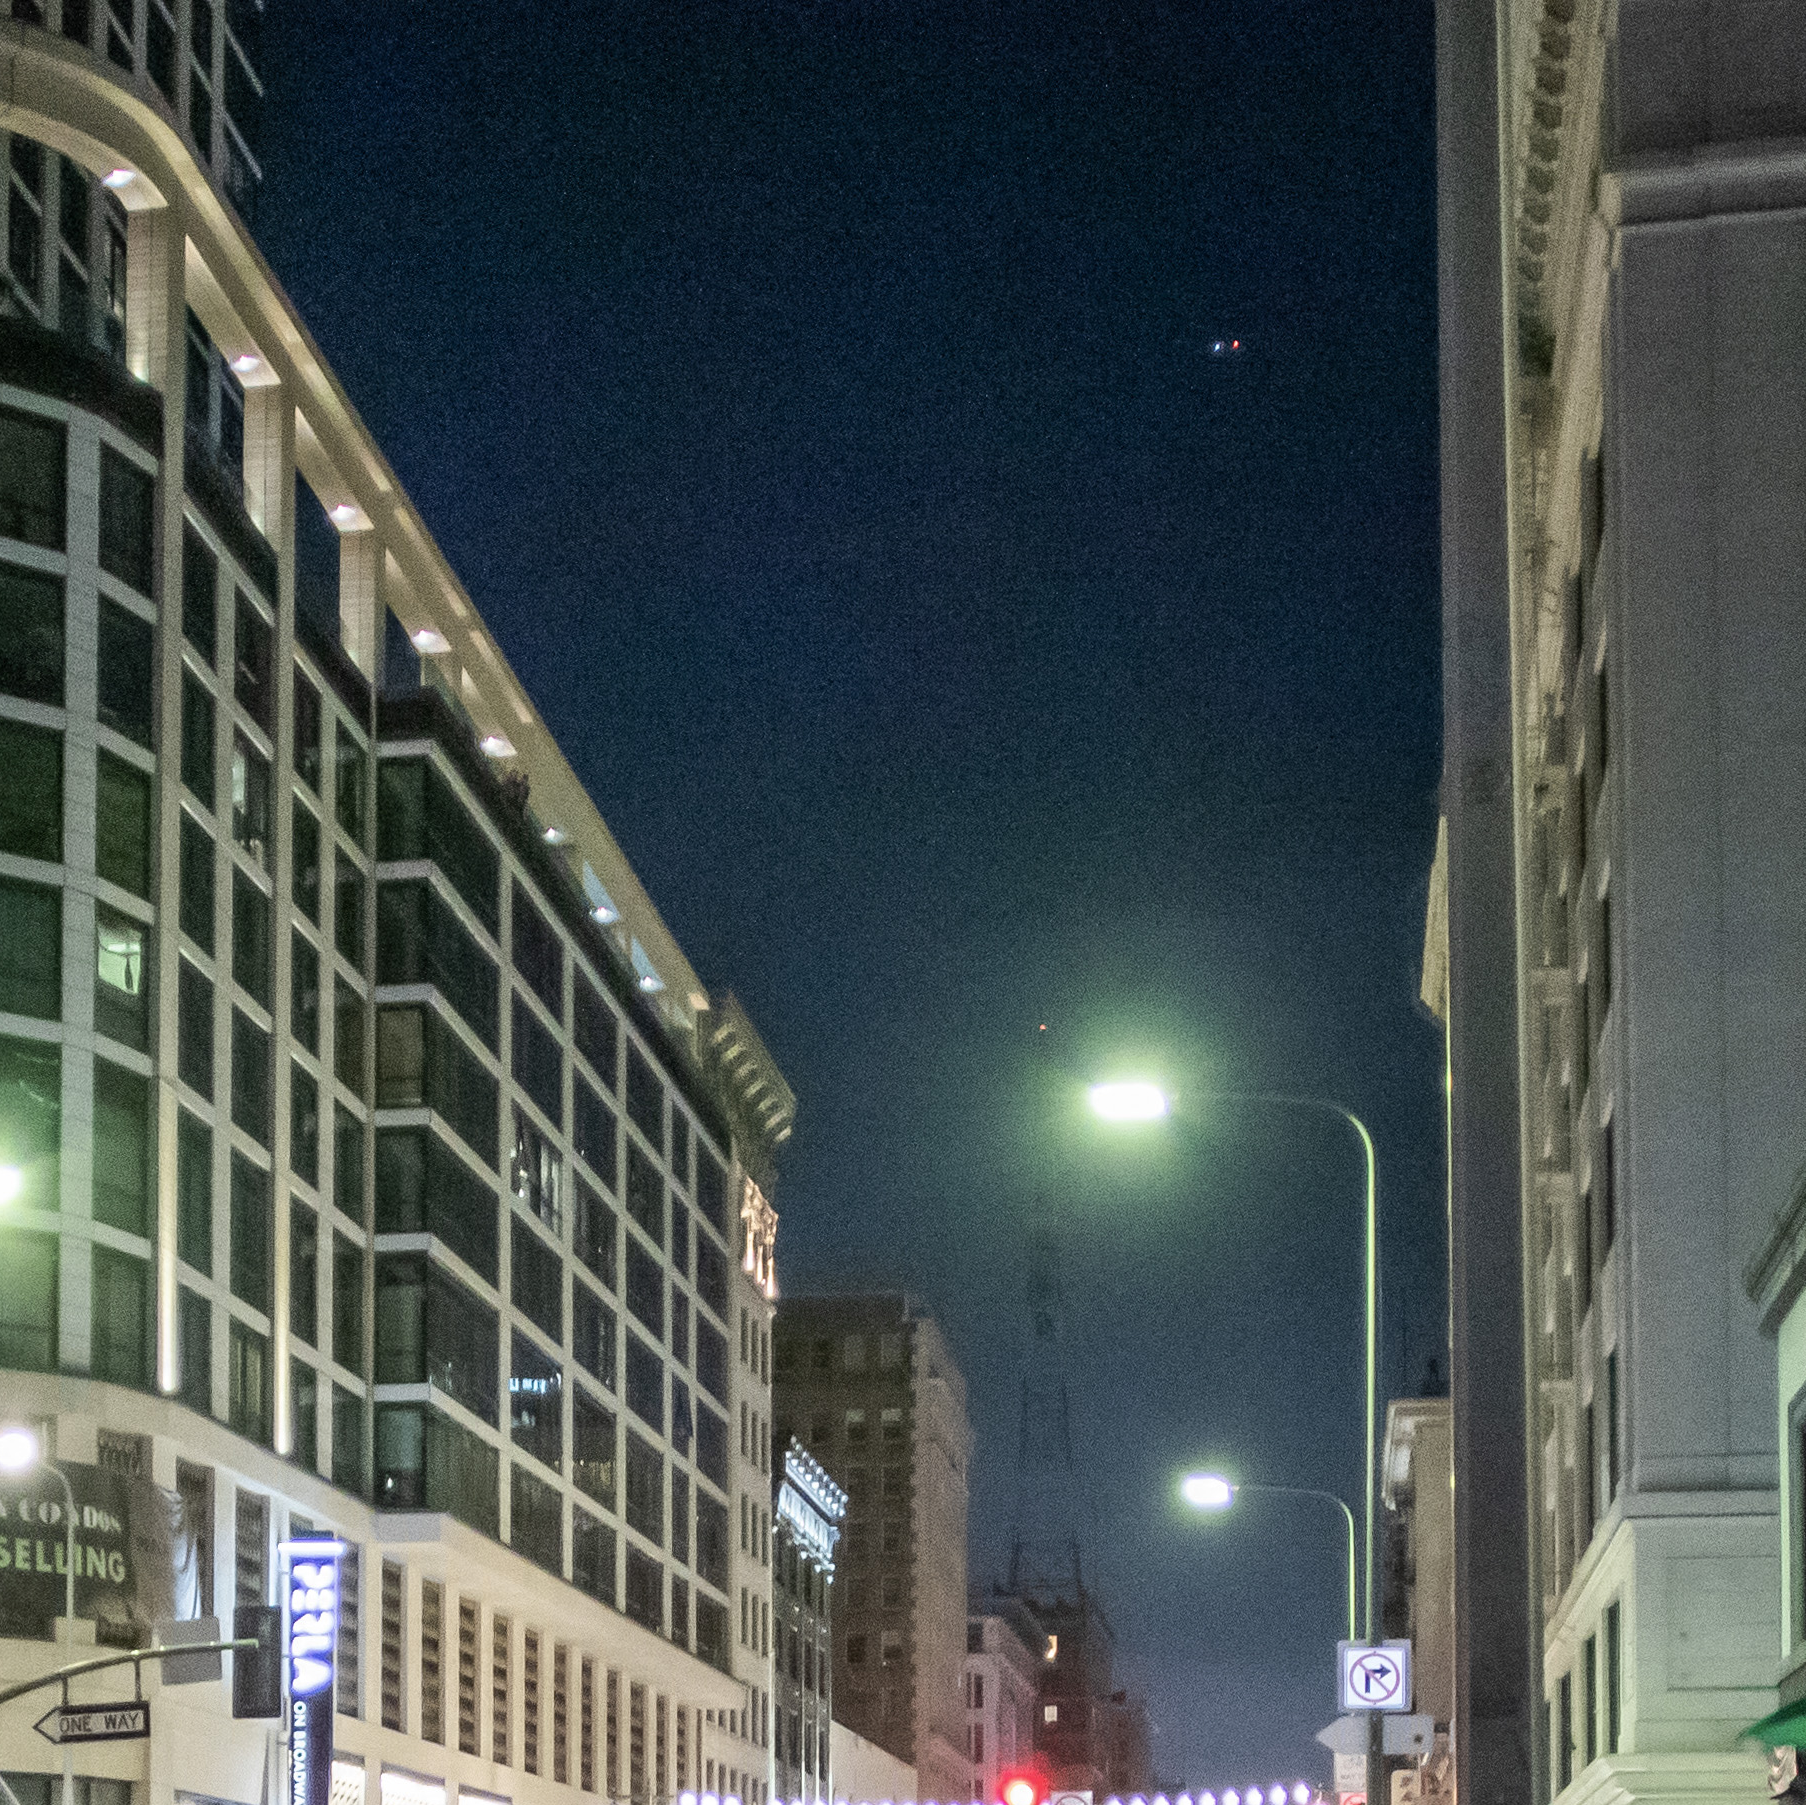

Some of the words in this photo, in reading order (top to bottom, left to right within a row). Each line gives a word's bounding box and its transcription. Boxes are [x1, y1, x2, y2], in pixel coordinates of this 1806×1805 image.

[292, 1561, 335, 1693] PERLA
[59, 1716, 92, 1733] ONE
[104, 1713, 139, 1730] WAY
[293, 1700, 307, 1727] ON
